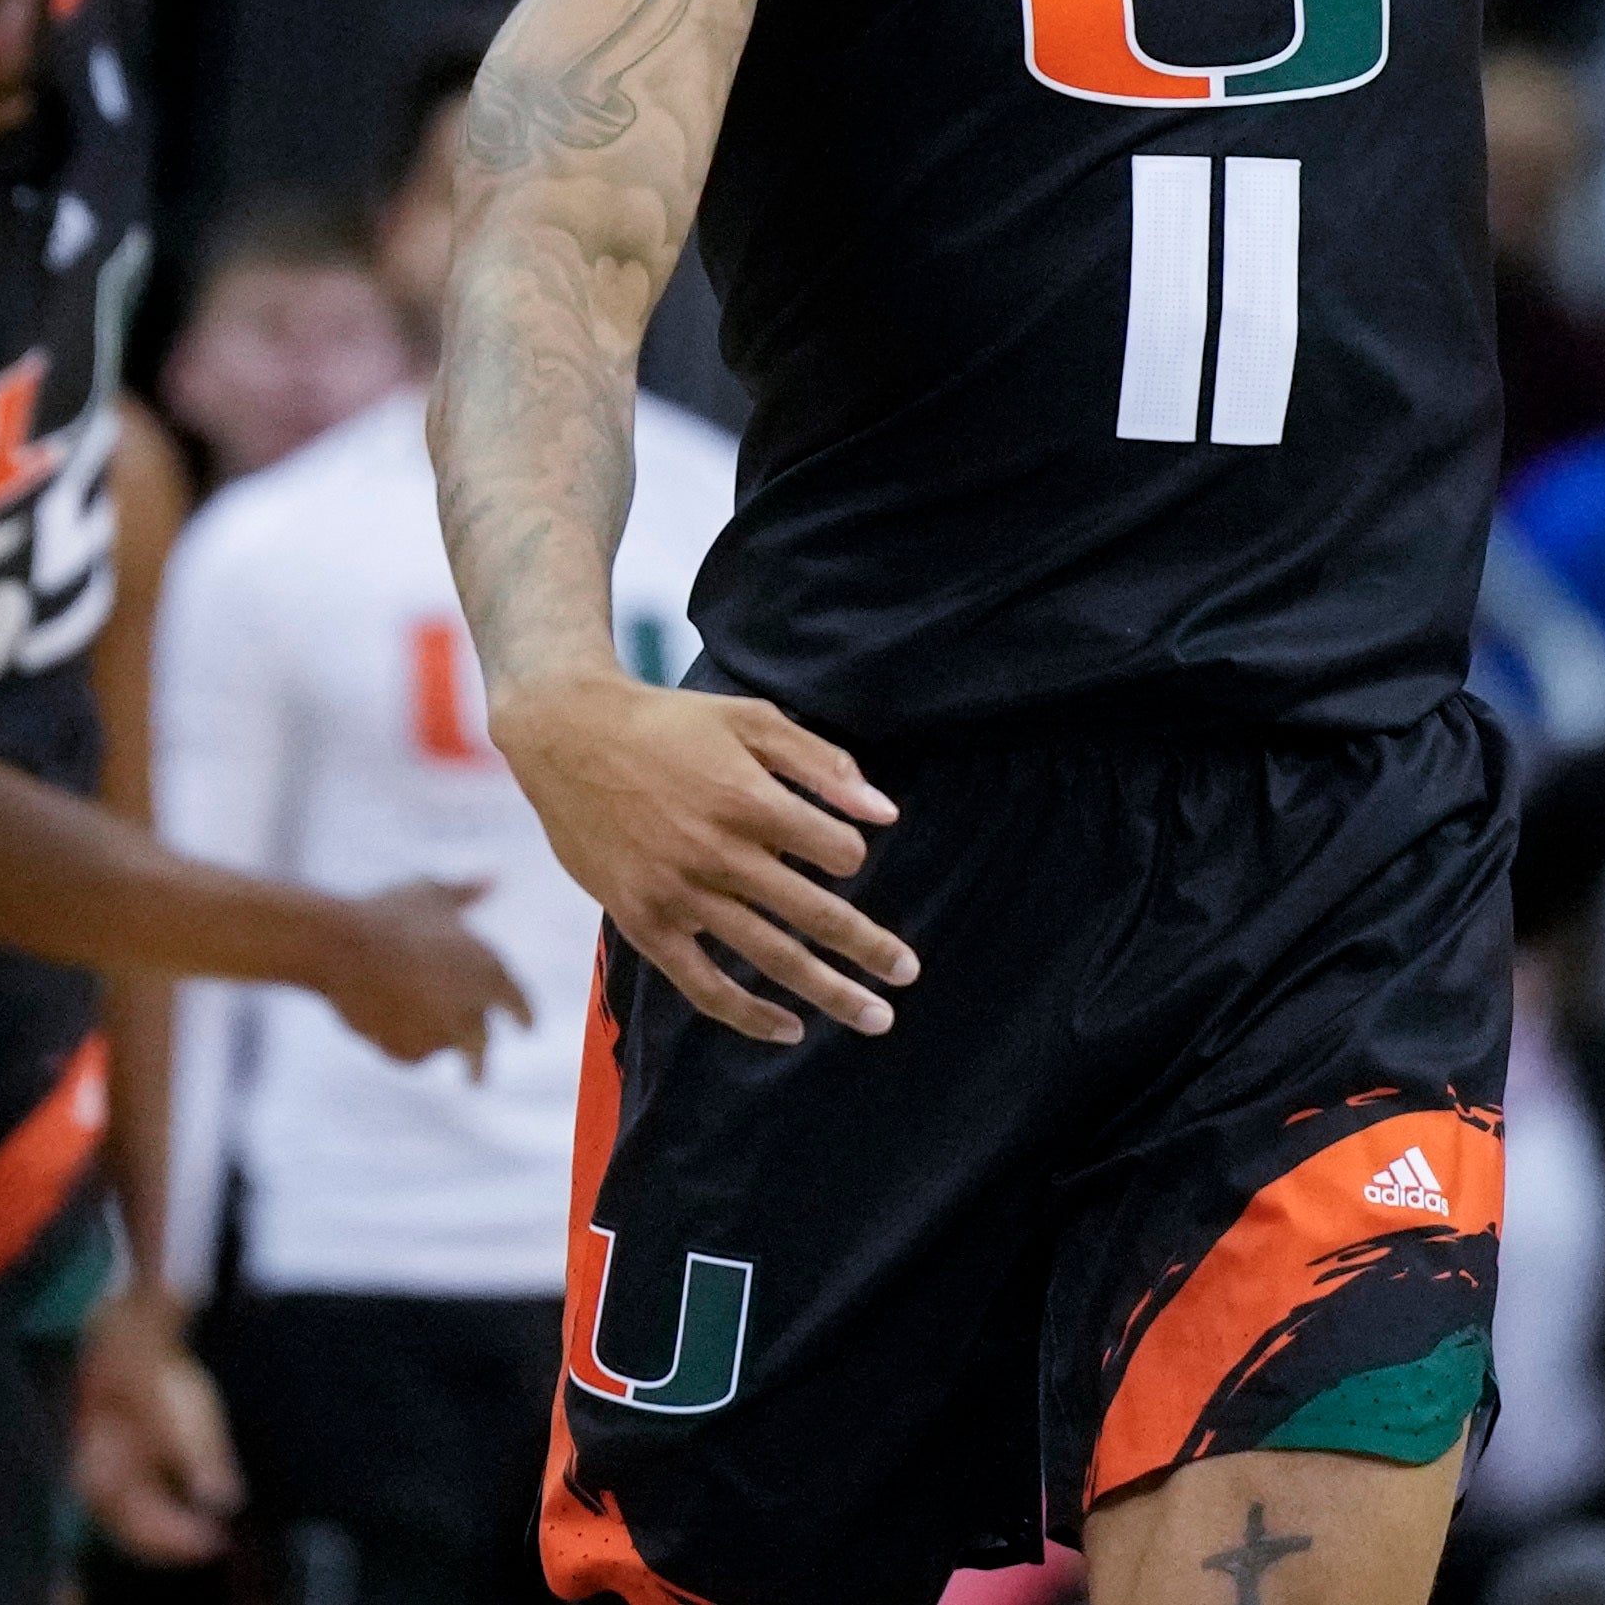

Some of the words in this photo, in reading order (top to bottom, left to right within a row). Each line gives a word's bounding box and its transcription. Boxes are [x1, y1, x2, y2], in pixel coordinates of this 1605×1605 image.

[1116, 154, 1302, 446] 11
[1363, 1183, 1449, 1217] adidas
[568, 1222, 754, 1415] U
